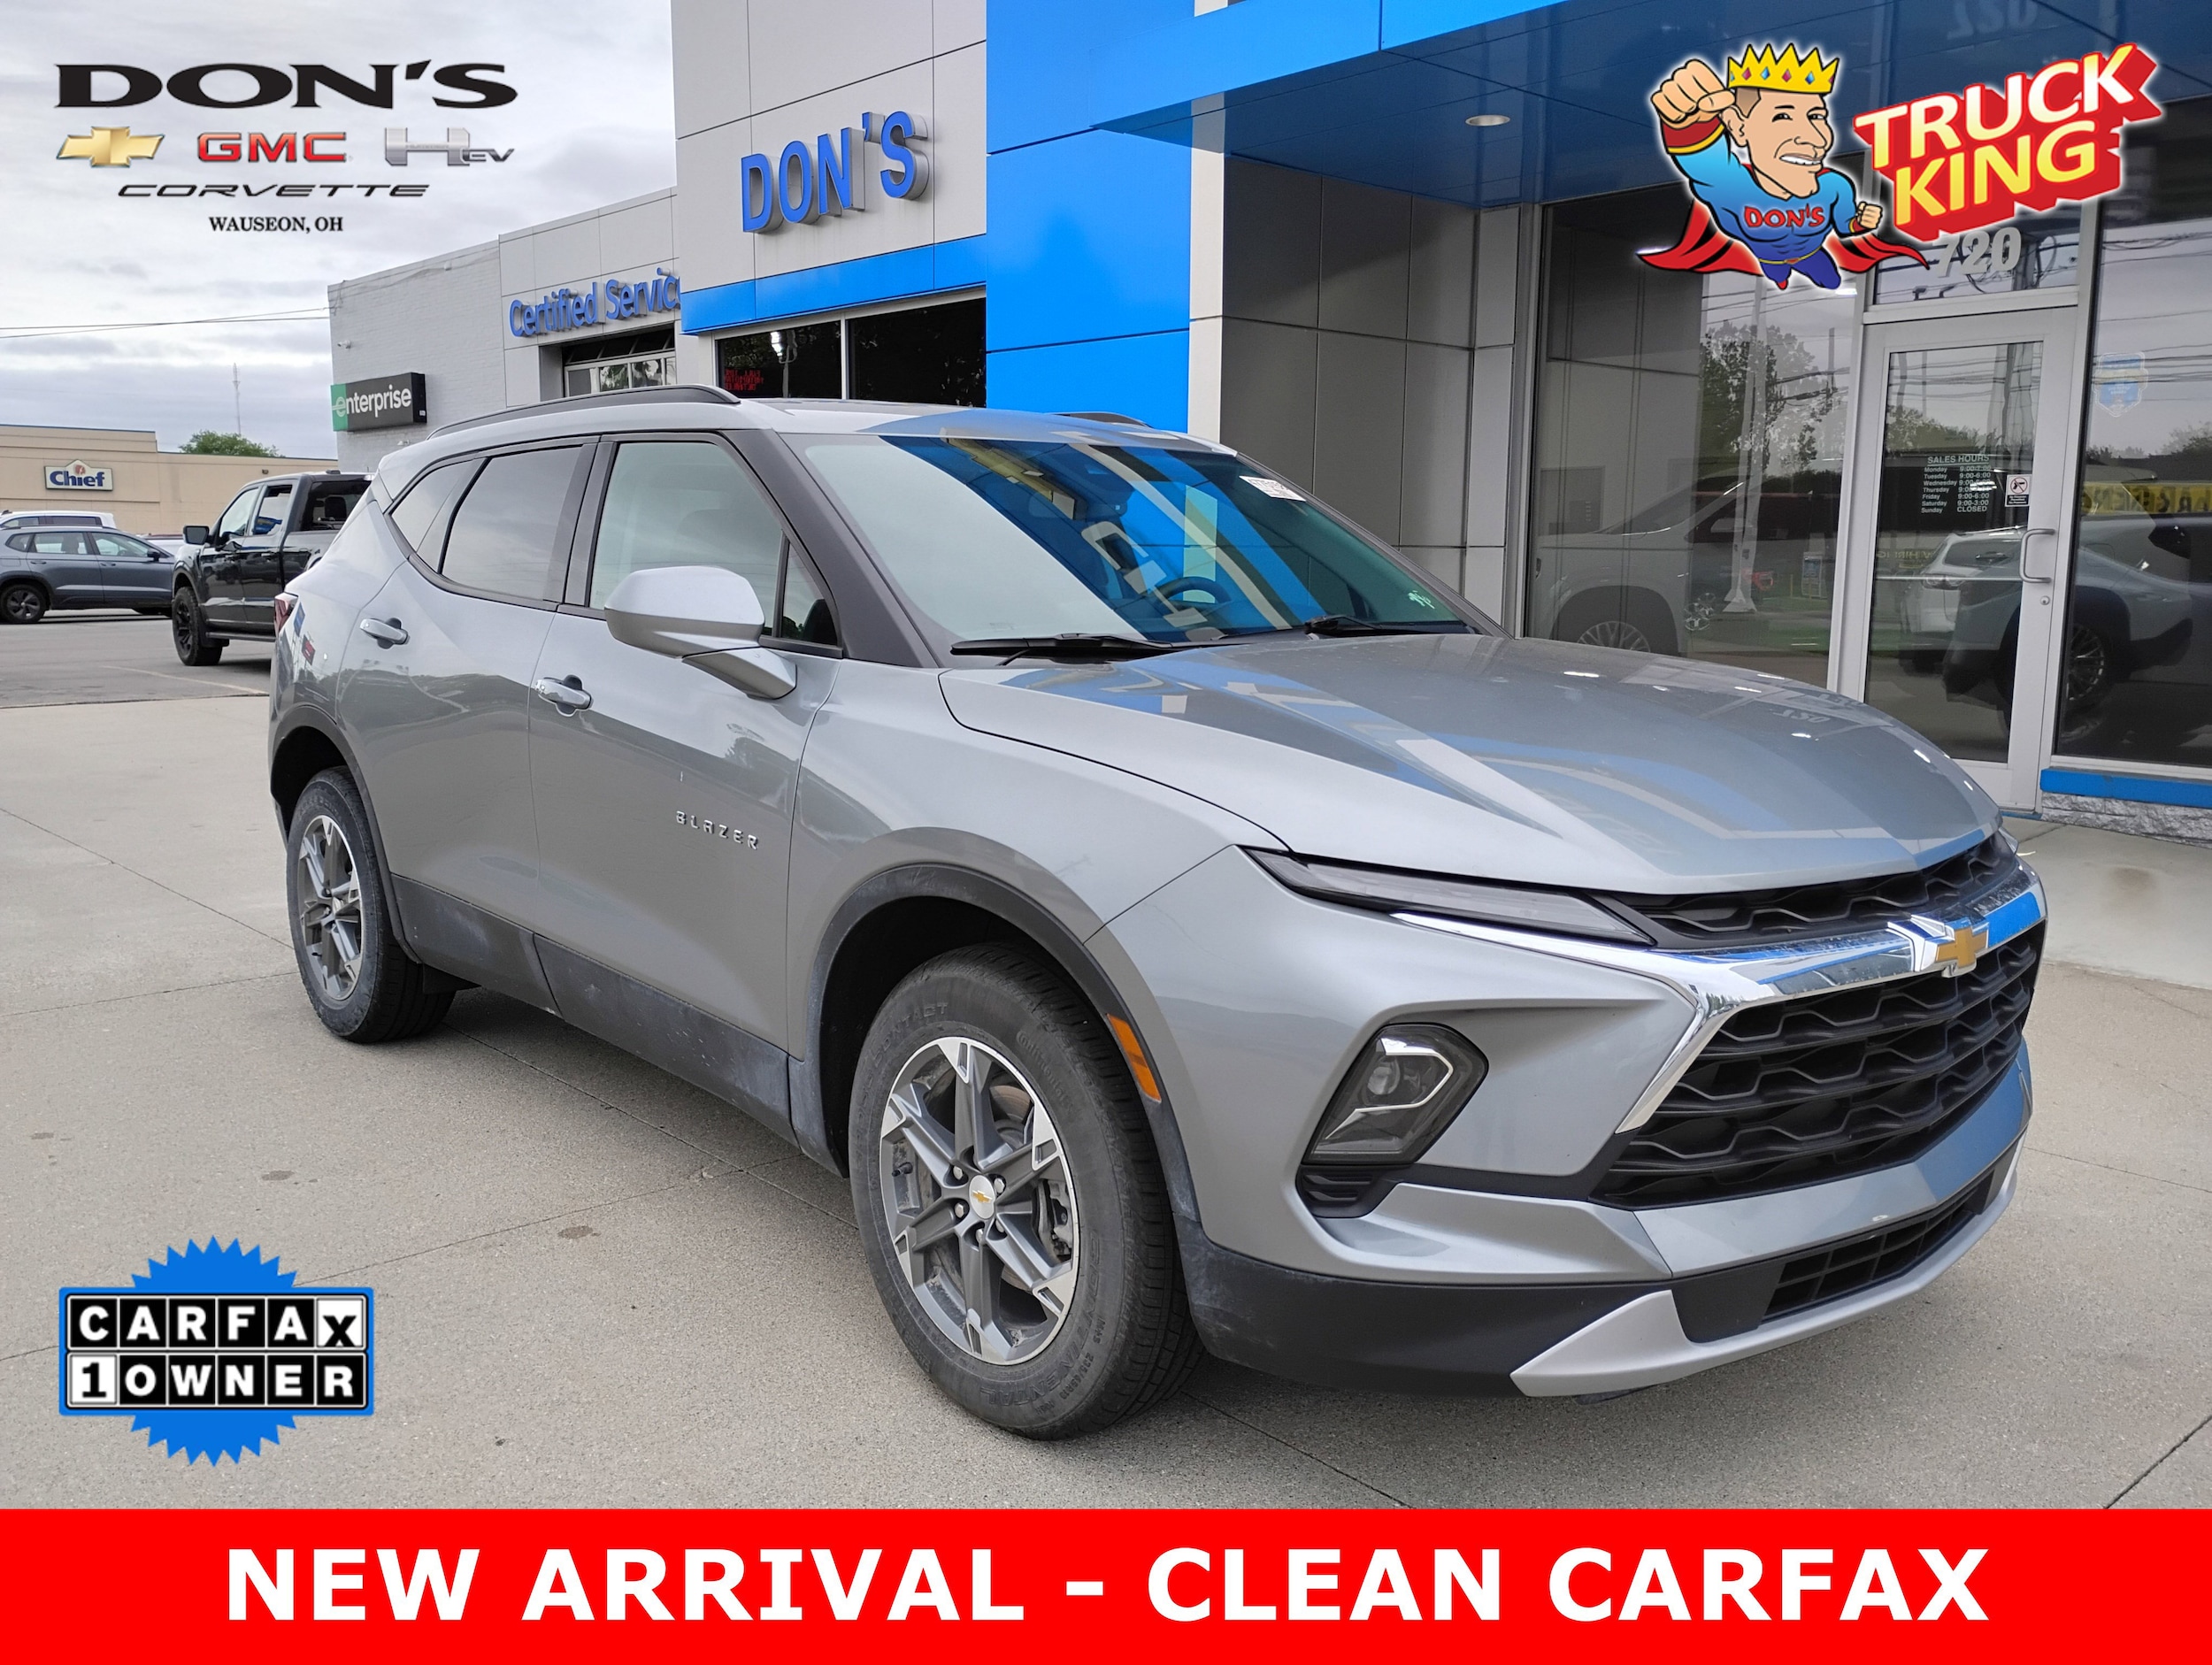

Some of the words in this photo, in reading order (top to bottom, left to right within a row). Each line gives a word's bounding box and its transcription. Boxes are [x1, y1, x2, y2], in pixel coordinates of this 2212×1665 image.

[741, 111, 926, 233] DON'S
[1932, 226, 2021, 278] 720
[510, 281, 600, 337] Certified
[332, 384, 411, 418] enterprise
[50, 471, 105, 487] Chief
[1927, 456, 1956, 464] SALES
[676, 810, 759, 850] BLAZER
